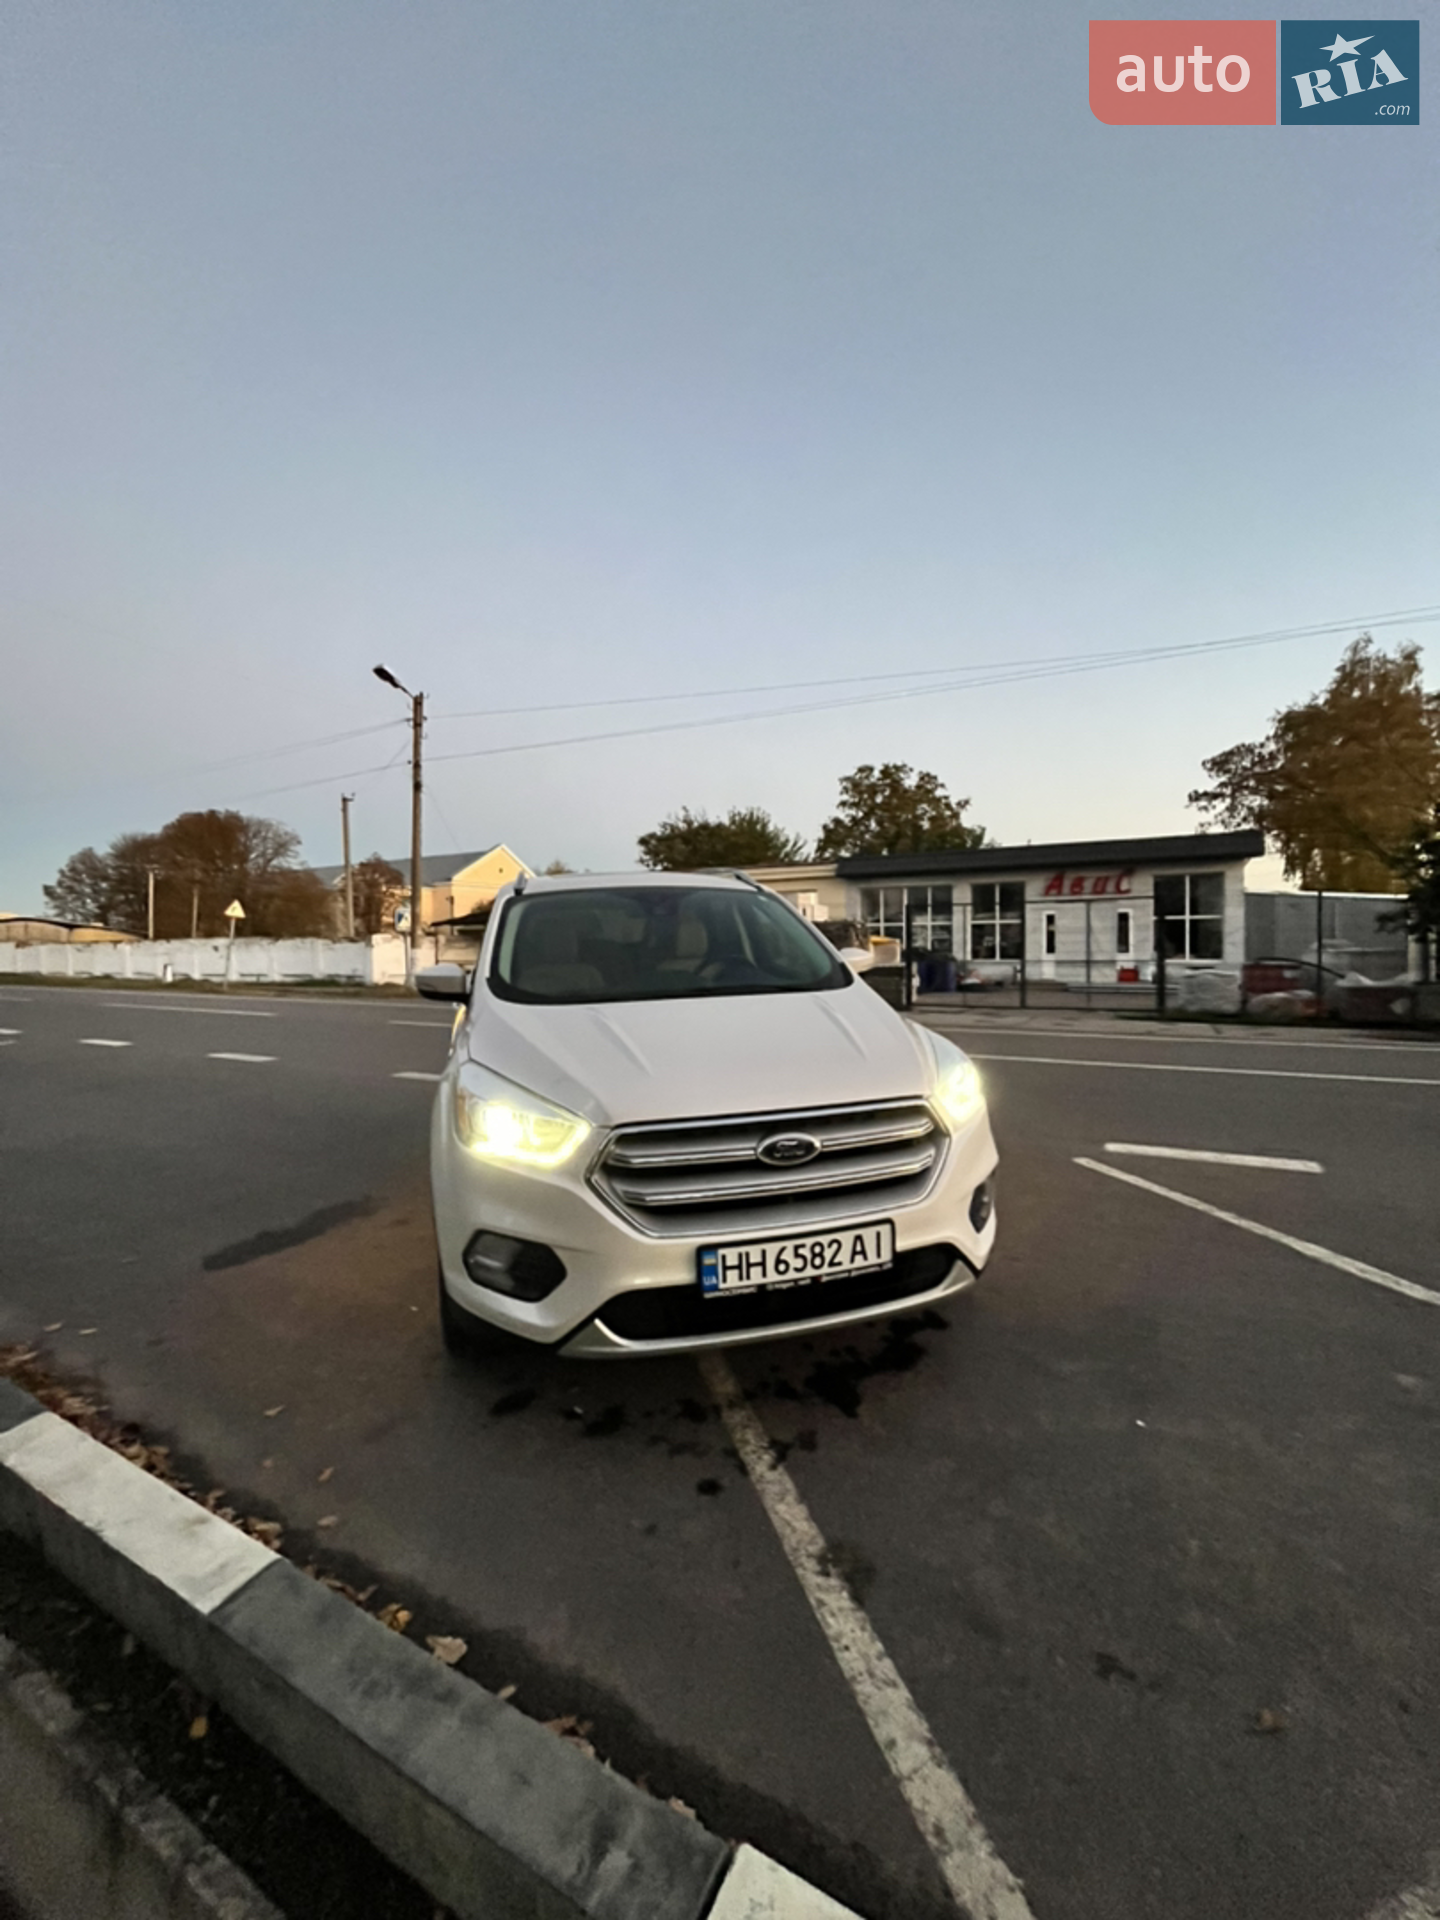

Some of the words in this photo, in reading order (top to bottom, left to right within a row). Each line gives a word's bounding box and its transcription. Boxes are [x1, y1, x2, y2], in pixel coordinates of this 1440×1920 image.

[721, 1249, 767, 1284] HH
[774, 1239, 842, 1276] 6582
[850, 1230, 881, 1264] AI
[703, 1275, 717, 1285] UA
